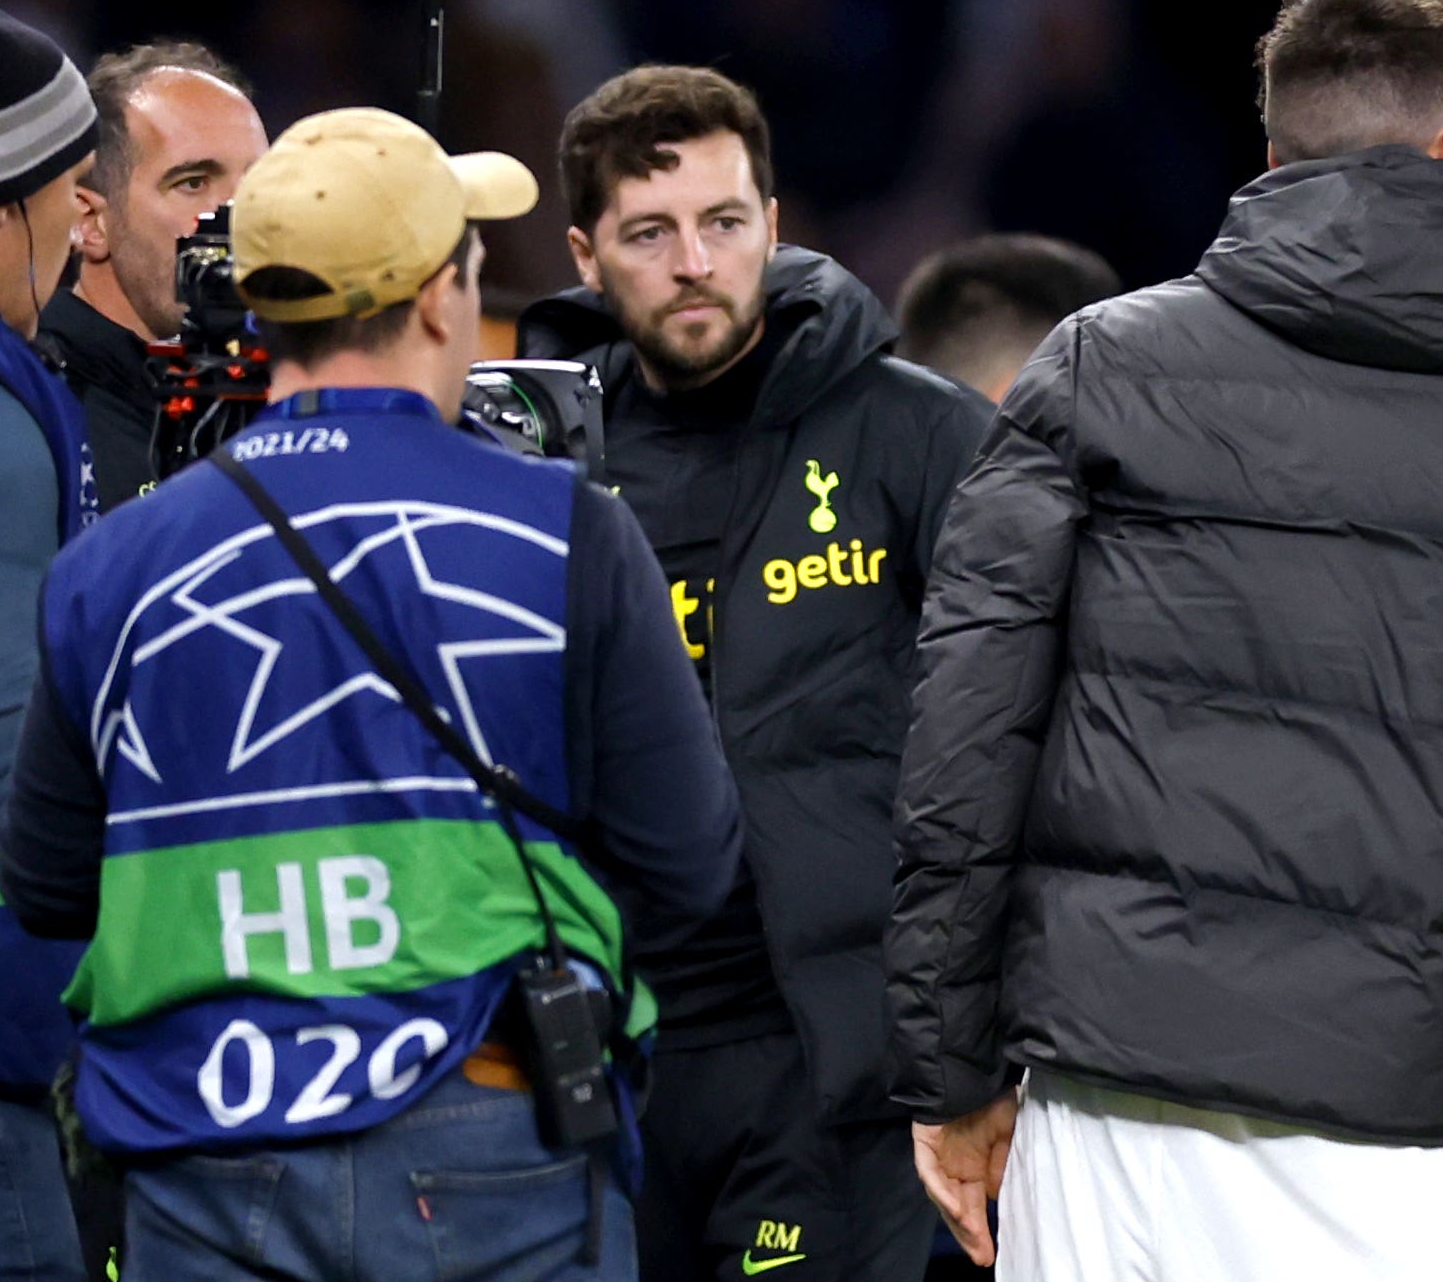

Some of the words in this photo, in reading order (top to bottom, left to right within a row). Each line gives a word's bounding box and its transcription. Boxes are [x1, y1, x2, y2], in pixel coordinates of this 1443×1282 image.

[763, 538, 888, 604] getir
[217, 855, 400, 979] HB
[756, 1220, 802, 1252] RM
